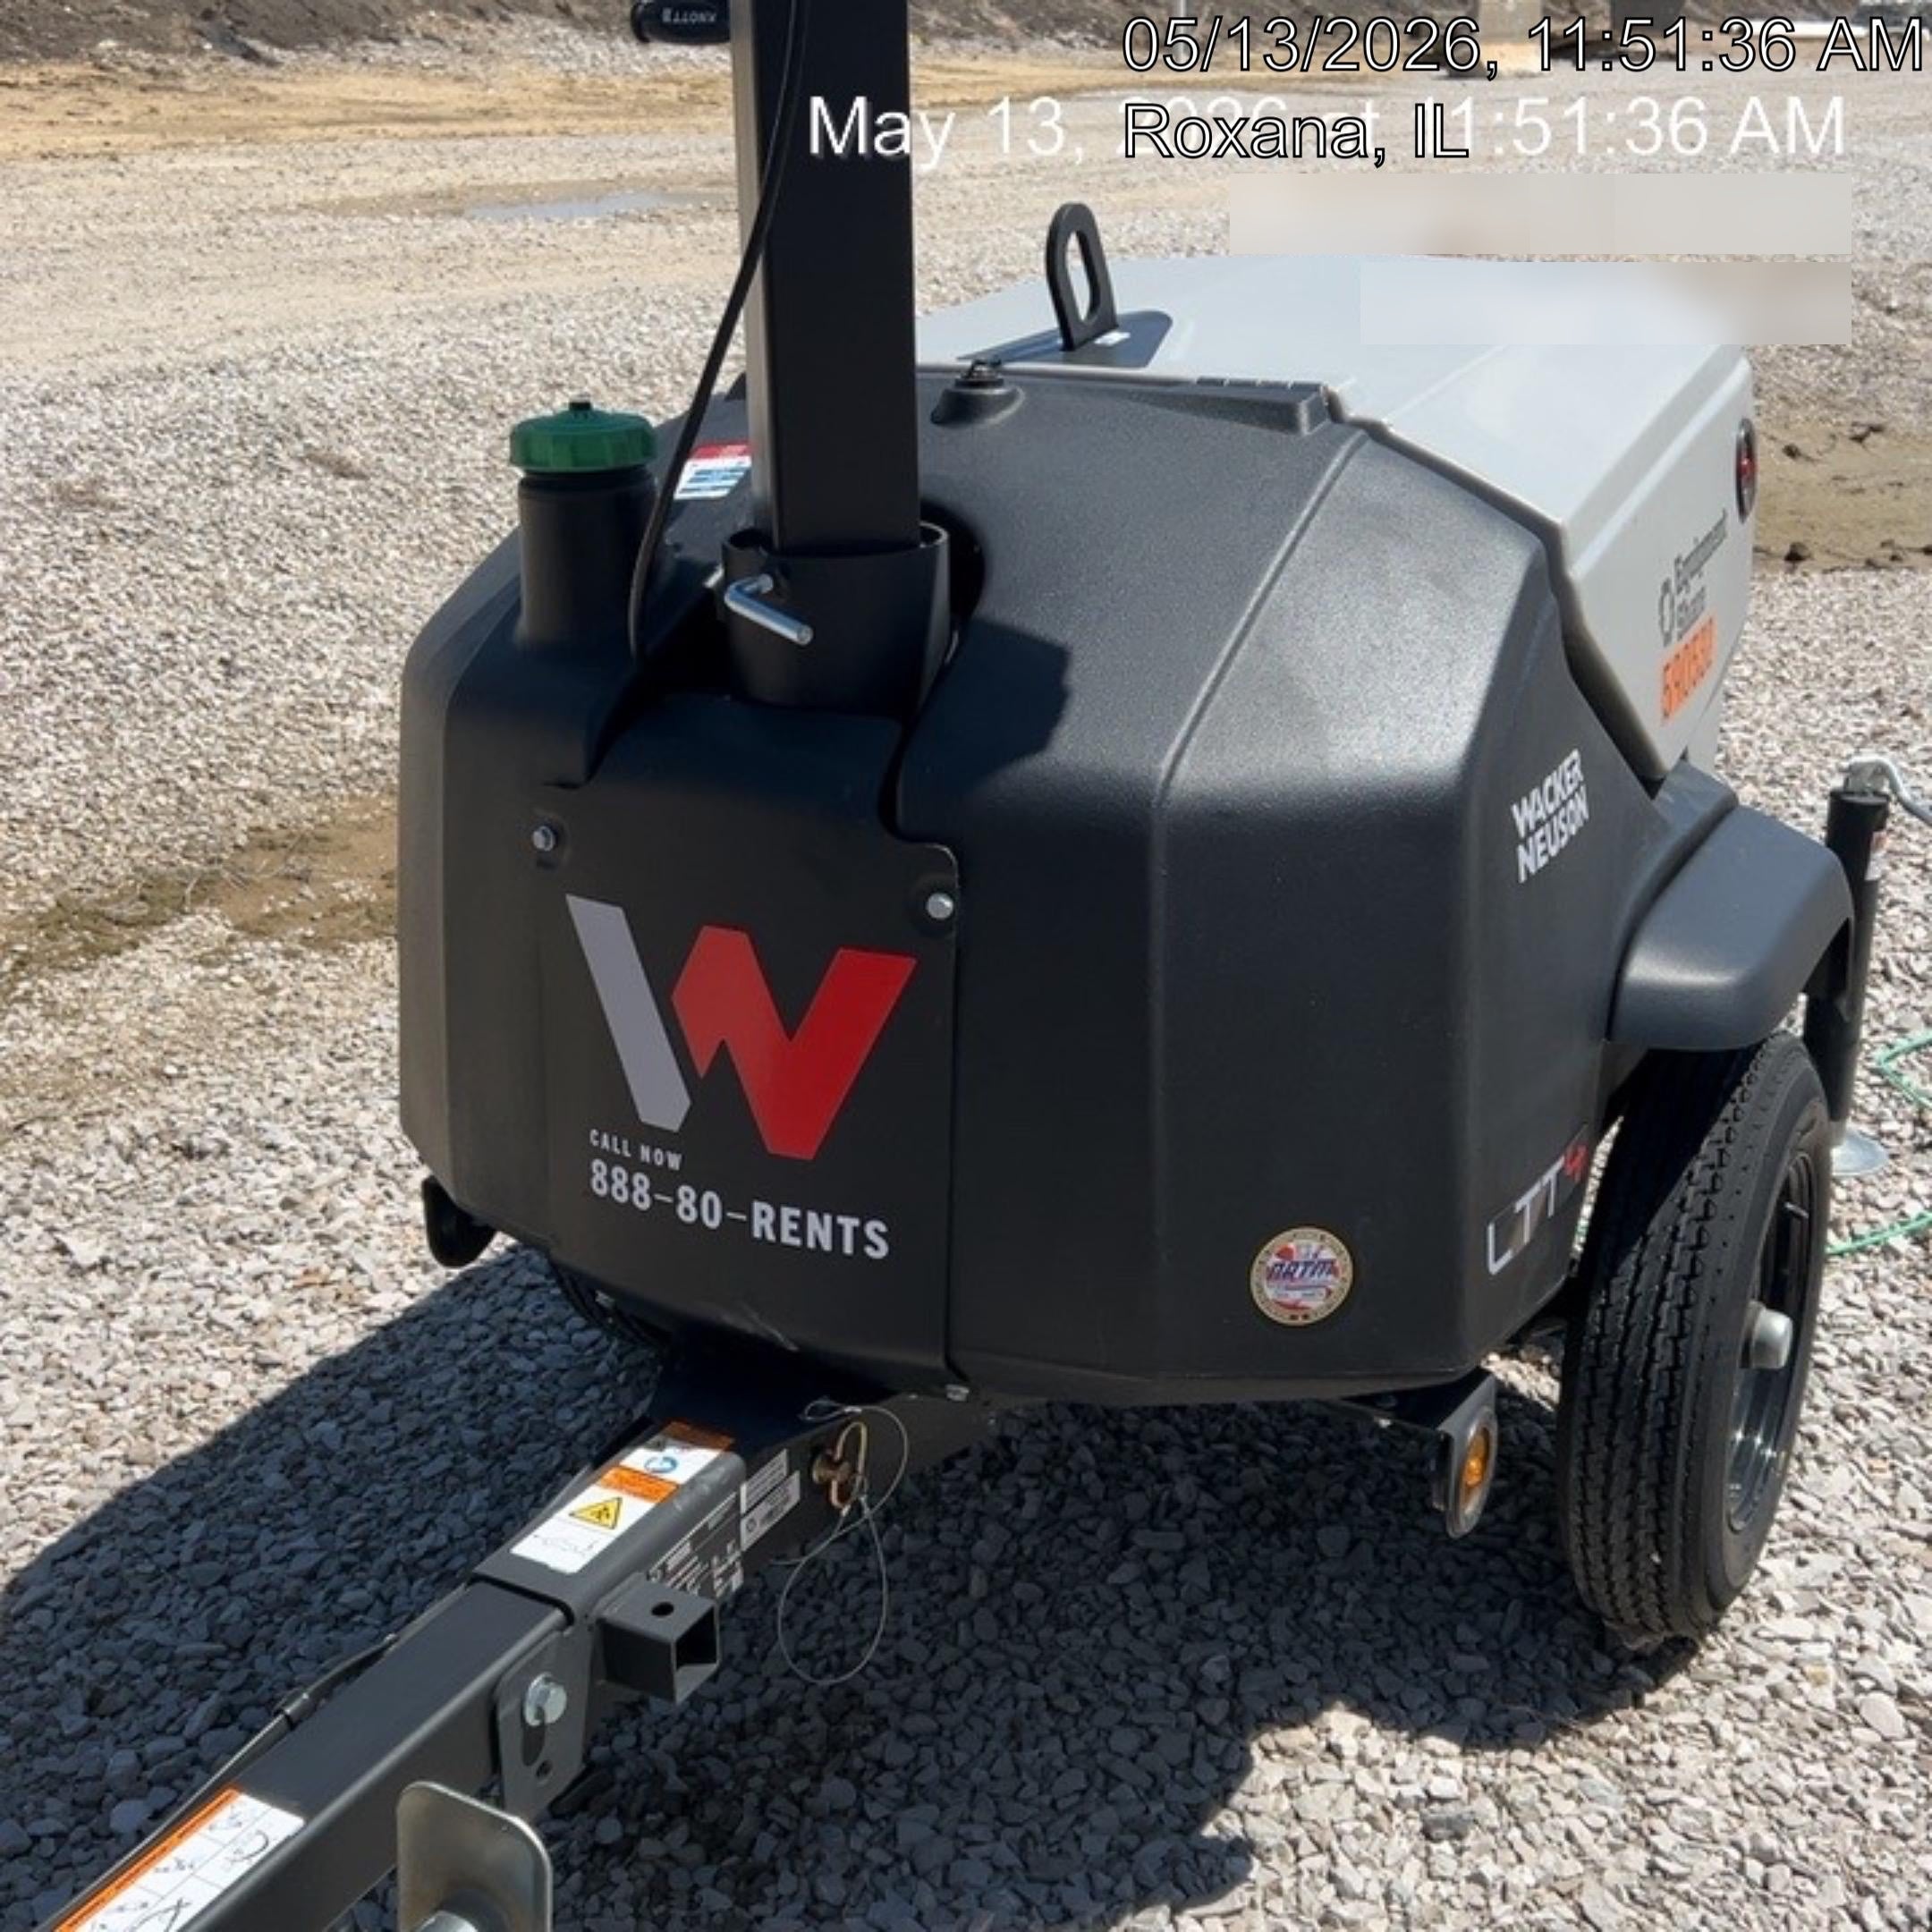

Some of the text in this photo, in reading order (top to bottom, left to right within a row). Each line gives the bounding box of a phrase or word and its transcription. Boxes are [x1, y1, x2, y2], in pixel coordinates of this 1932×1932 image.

[1512, 748, 1583, 838] WACKER
[1517, 784, 1589, 884] NEUSON
[589, 1129, 682, 1172] CALL NOW
[590, 1158, 890, 1260] 888-80-RENTS
